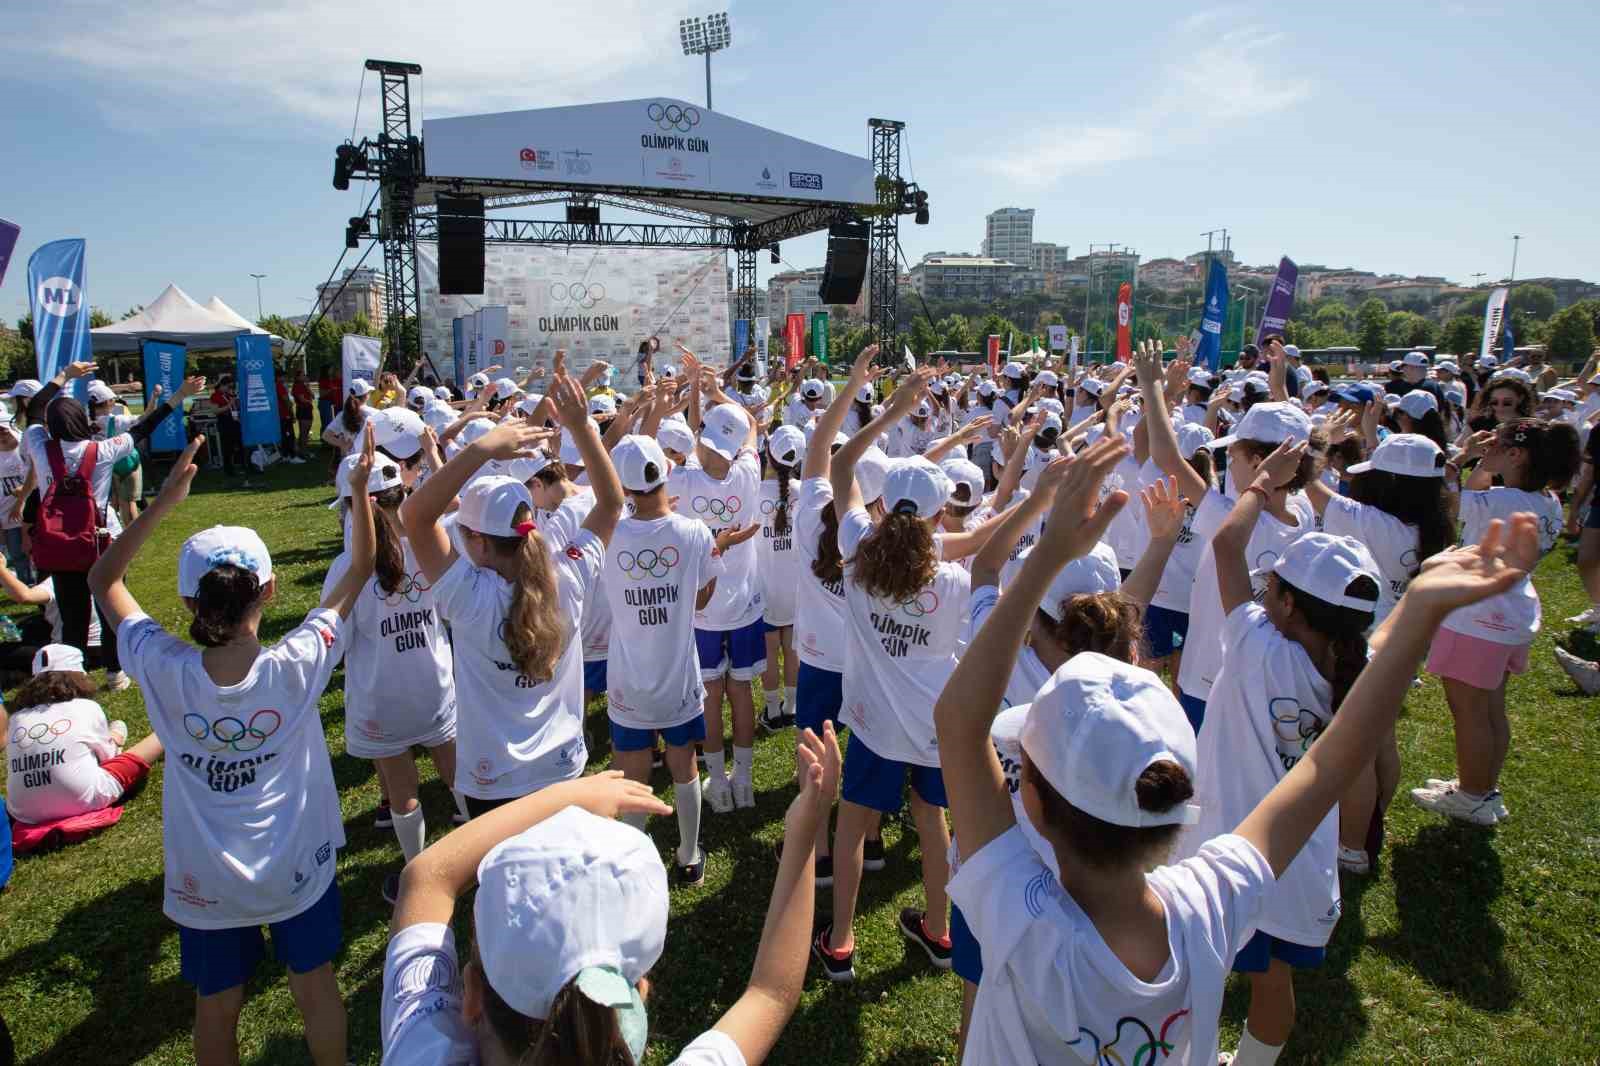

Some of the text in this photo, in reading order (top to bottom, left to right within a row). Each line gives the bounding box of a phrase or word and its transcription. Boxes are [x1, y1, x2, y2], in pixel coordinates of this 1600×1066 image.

[641, 133, 709, 152] OLİMPİK GÜN
[538, 314, 619, 332] OLİMPİK GÜN
[625, 584, 679, 606] OLİMPİK
[381, 609, 432, 638] OLİMPK
[639, 606, 668, 626] GÜN
[395, 631, 426, 653] GÜN
[11, 748, 66, 773] OLİMPİK
[23, 770, 52, 788] GÜN
